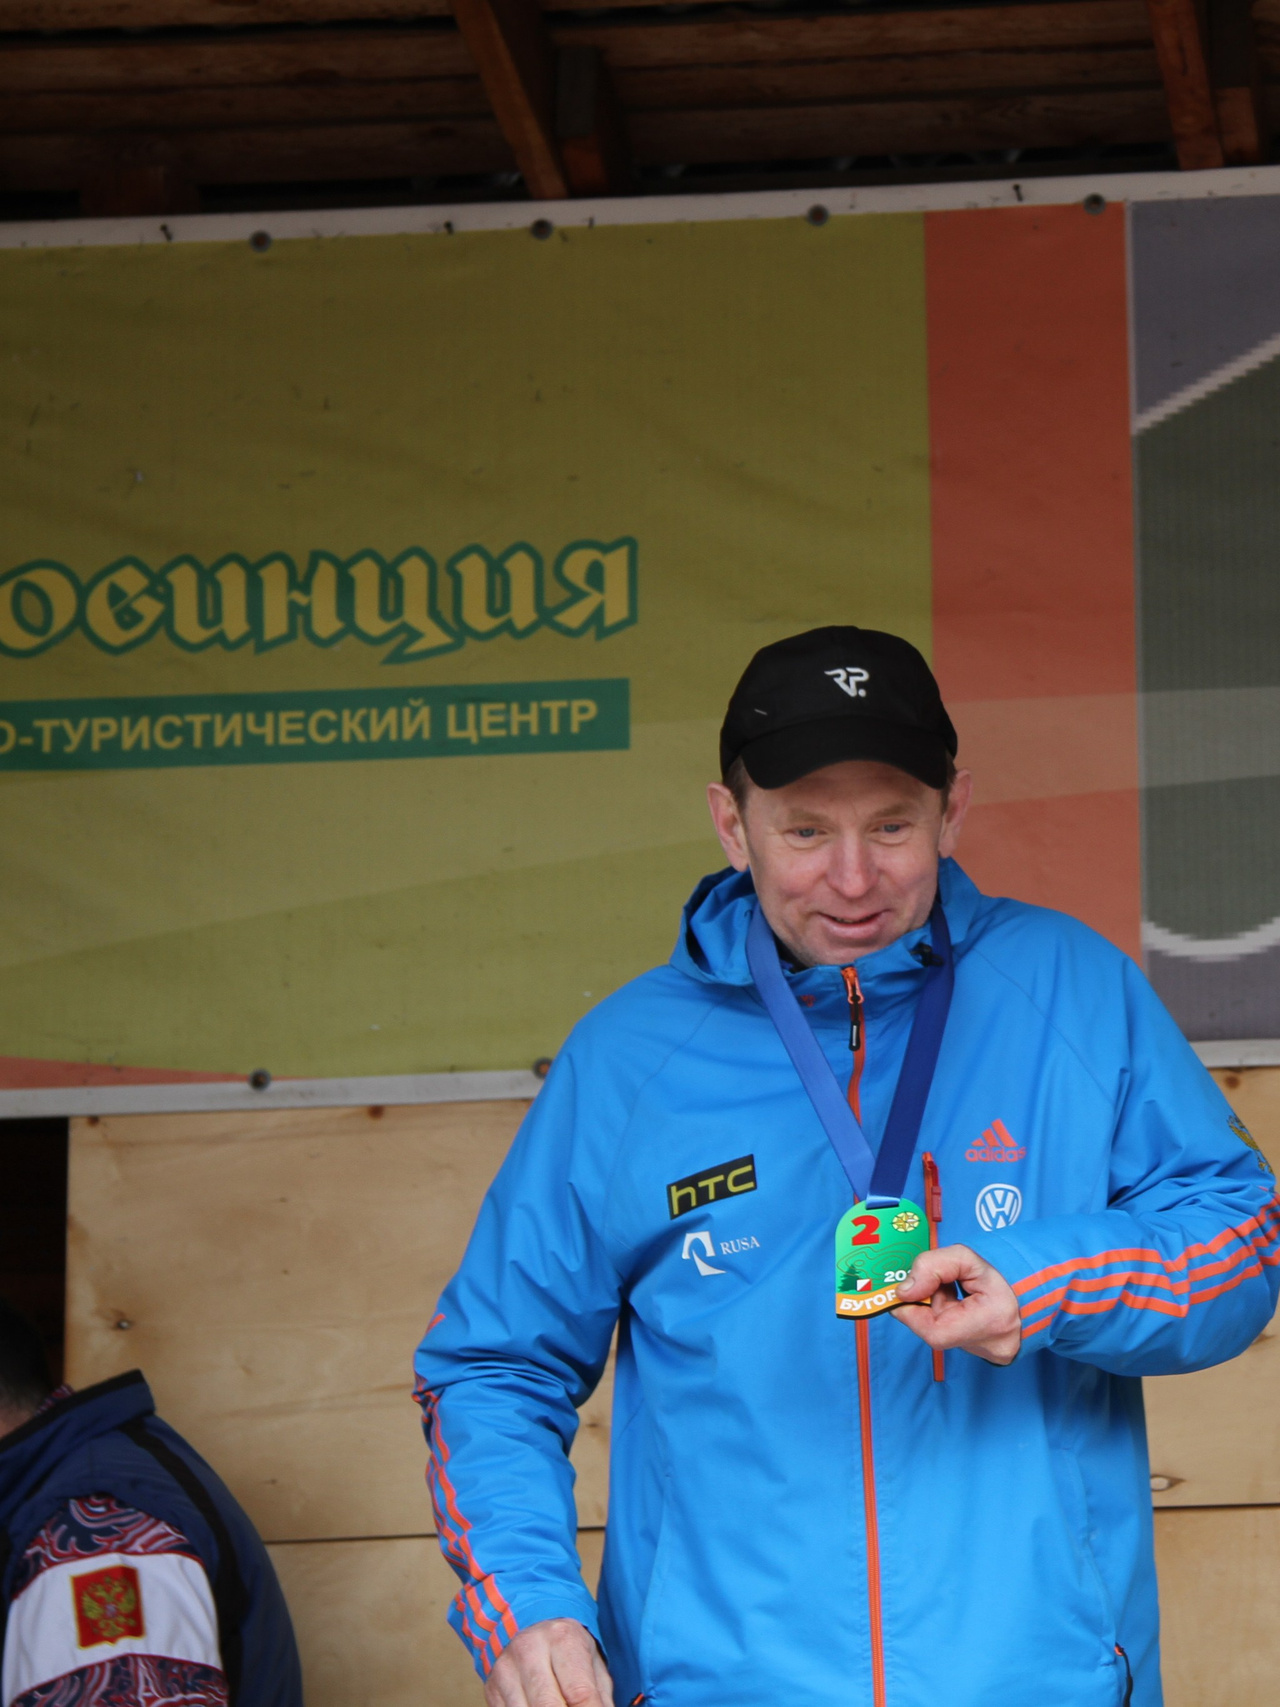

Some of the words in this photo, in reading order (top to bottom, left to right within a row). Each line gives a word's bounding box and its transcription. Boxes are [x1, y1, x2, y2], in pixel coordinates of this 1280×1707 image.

[445, 699, 598, 744] ЦЕНТР
[964, 1146, 1026, 1162] adidas
[850, 1214, 880, 1246] 2
[883, 1269, 912, 1283] 20
